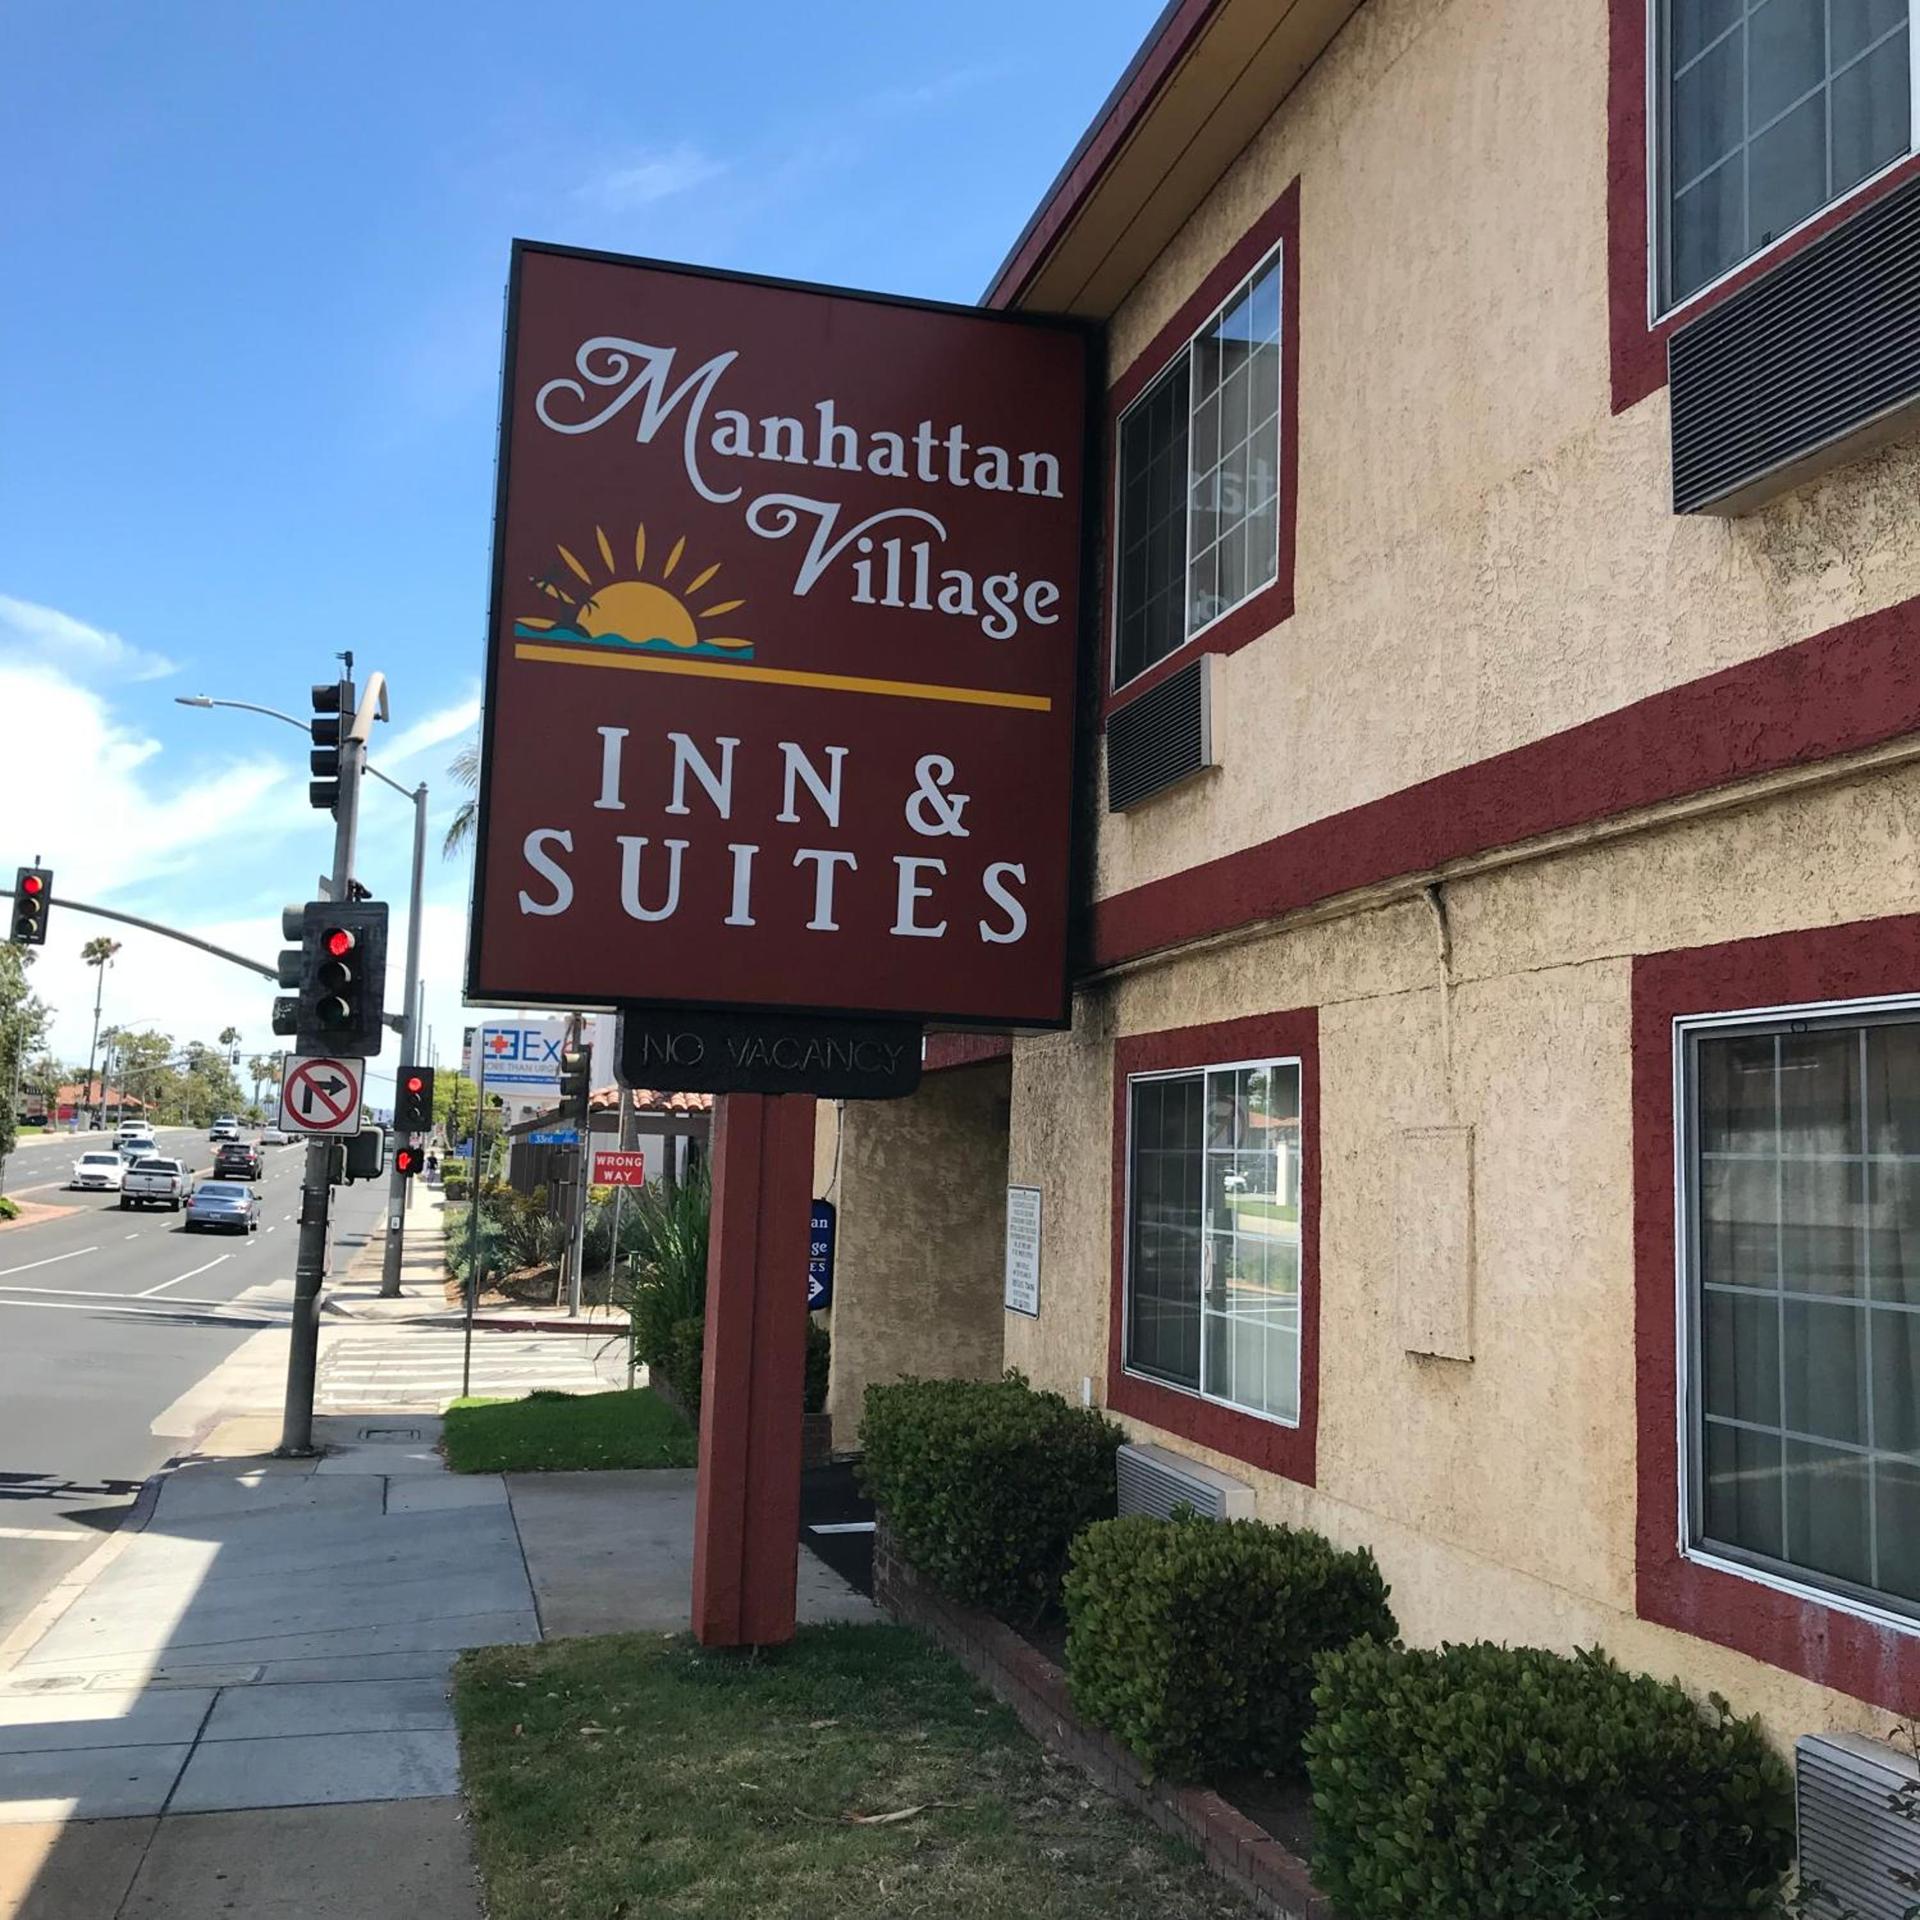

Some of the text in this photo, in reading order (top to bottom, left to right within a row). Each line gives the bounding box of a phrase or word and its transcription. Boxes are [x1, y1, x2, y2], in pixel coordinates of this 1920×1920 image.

[535, 336, 1064, 504] Manhattan
[745, 492, 1061, 640] Village
[594, 726, 971, 838] INN &
[518, 828, 1028, 944] SUITES
[641, 1032, 905, 1075] NO VACANCY
[596, 1154, 643, 1167] WRONG
[603, 1170, 633, 1182] WAY
